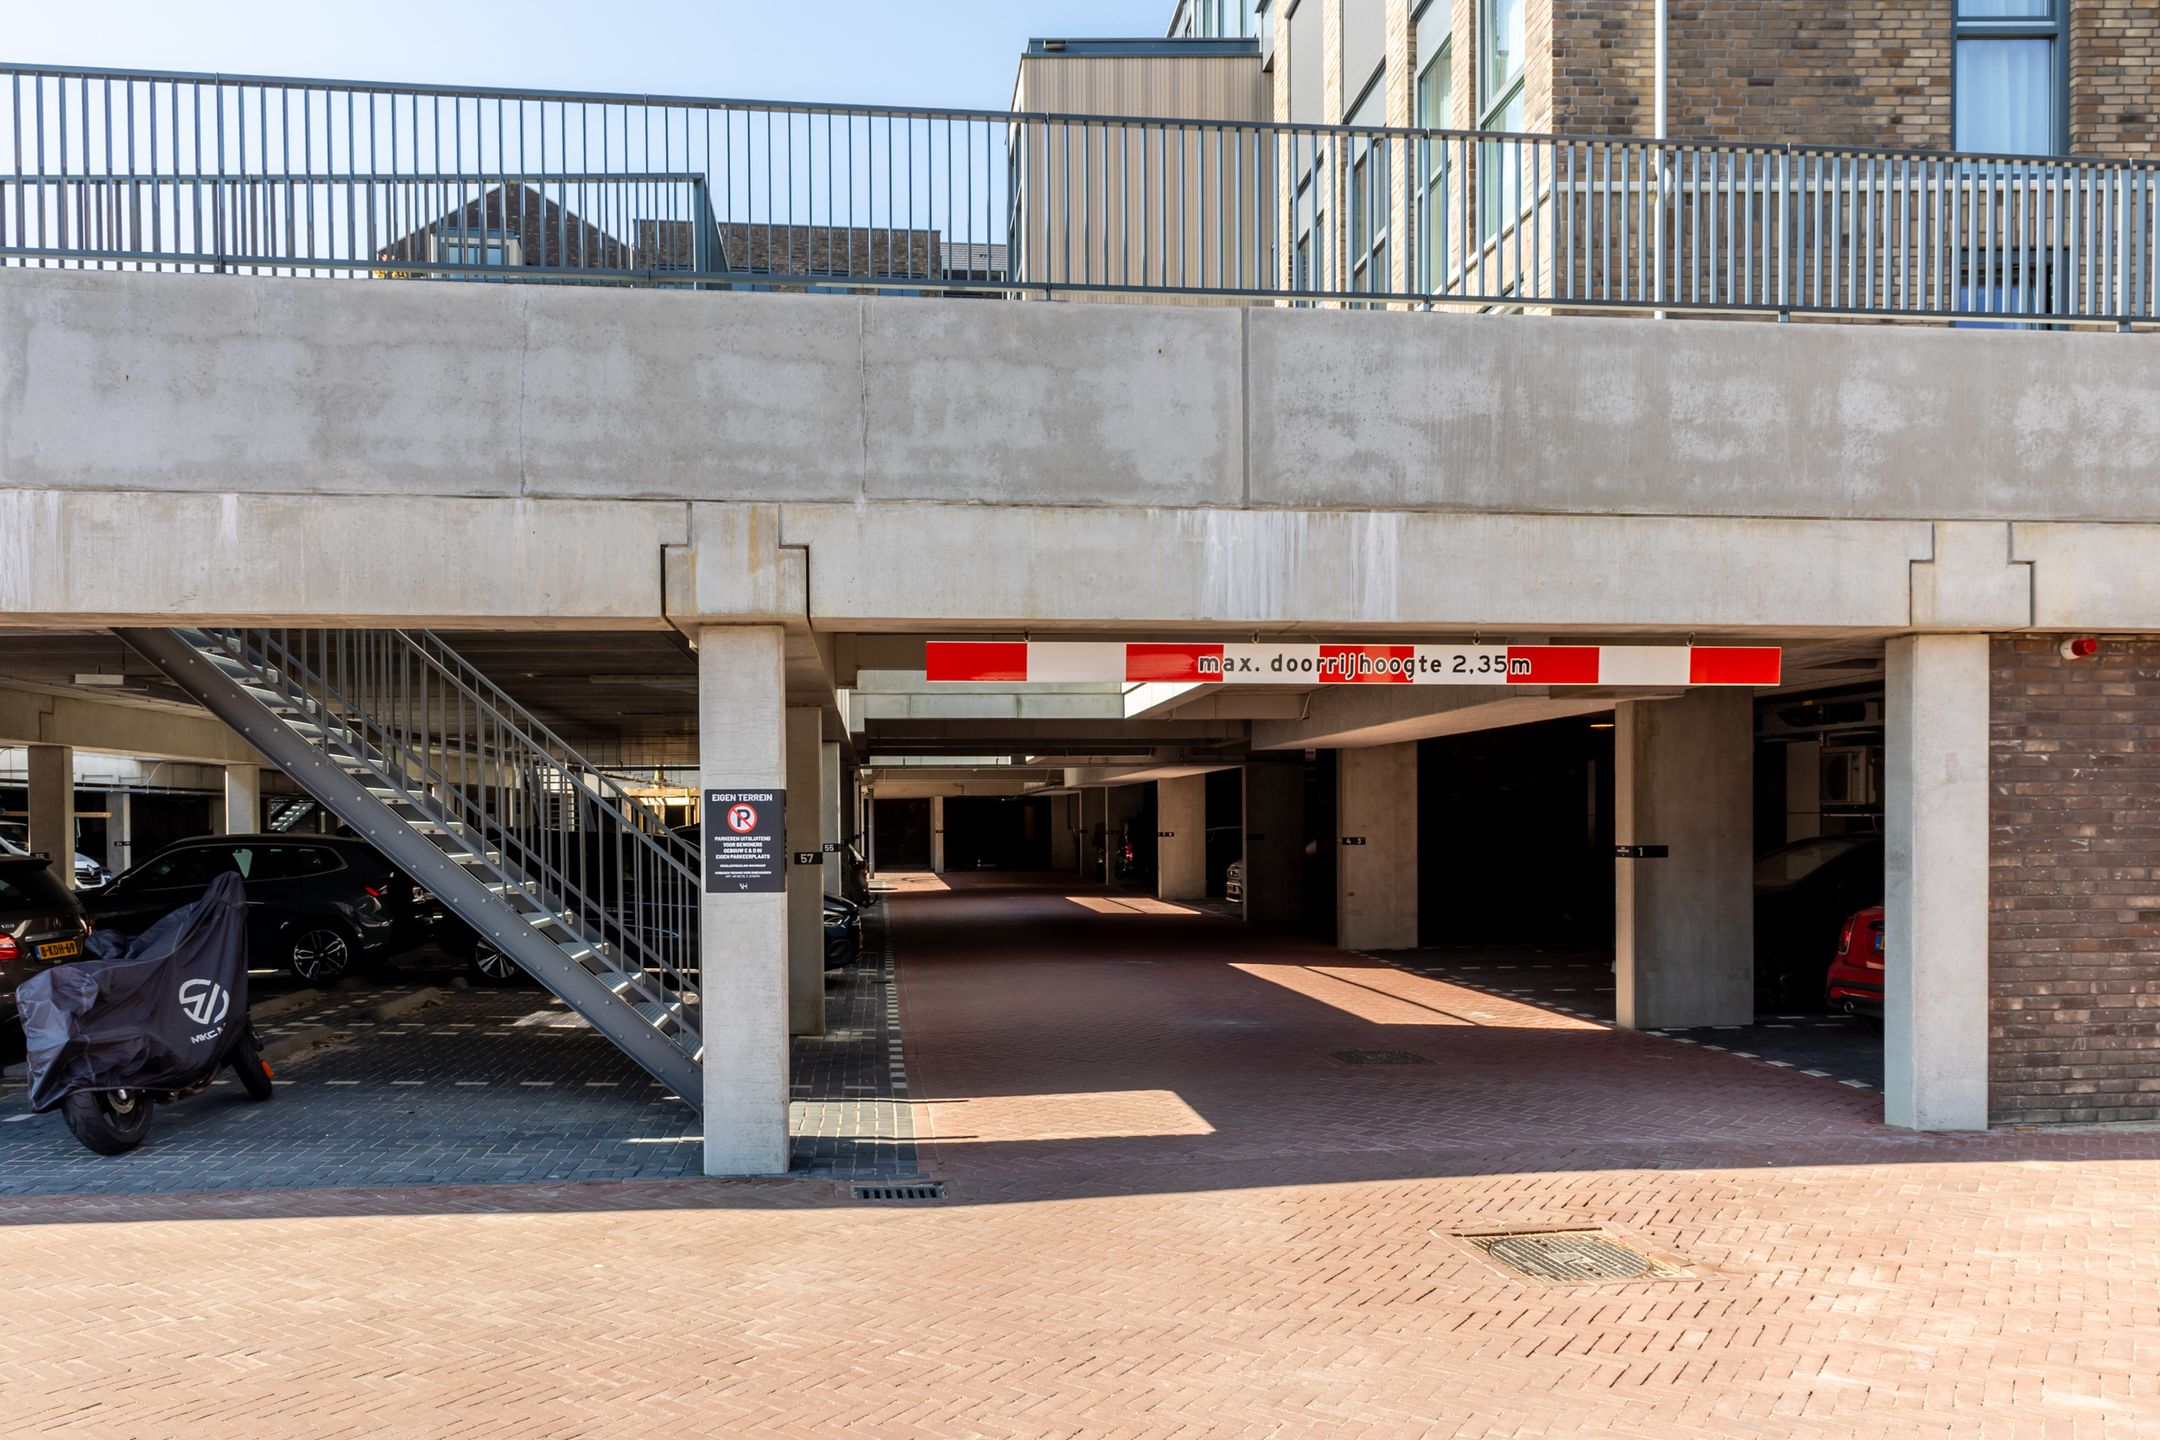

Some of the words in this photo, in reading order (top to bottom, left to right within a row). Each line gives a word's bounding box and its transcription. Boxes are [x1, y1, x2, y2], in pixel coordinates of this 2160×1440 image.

[1198, 656, 1260, 673] max.
[1270, 653, 1442, 680] doorrijhoogte
[1452, 655, 1531, 675] 2,35m
[711, 793, 736, 802] EIGEN
[737, 793, 773, 802] TERREIN
[824, 844, 835, 852] 55
[1638, 847, 1643, 857] 1
[800, 853, 814, 864] 57
[40, 941, 76, 957] 8-KDH-69
[190, 1029, 218, 1044] MKC
